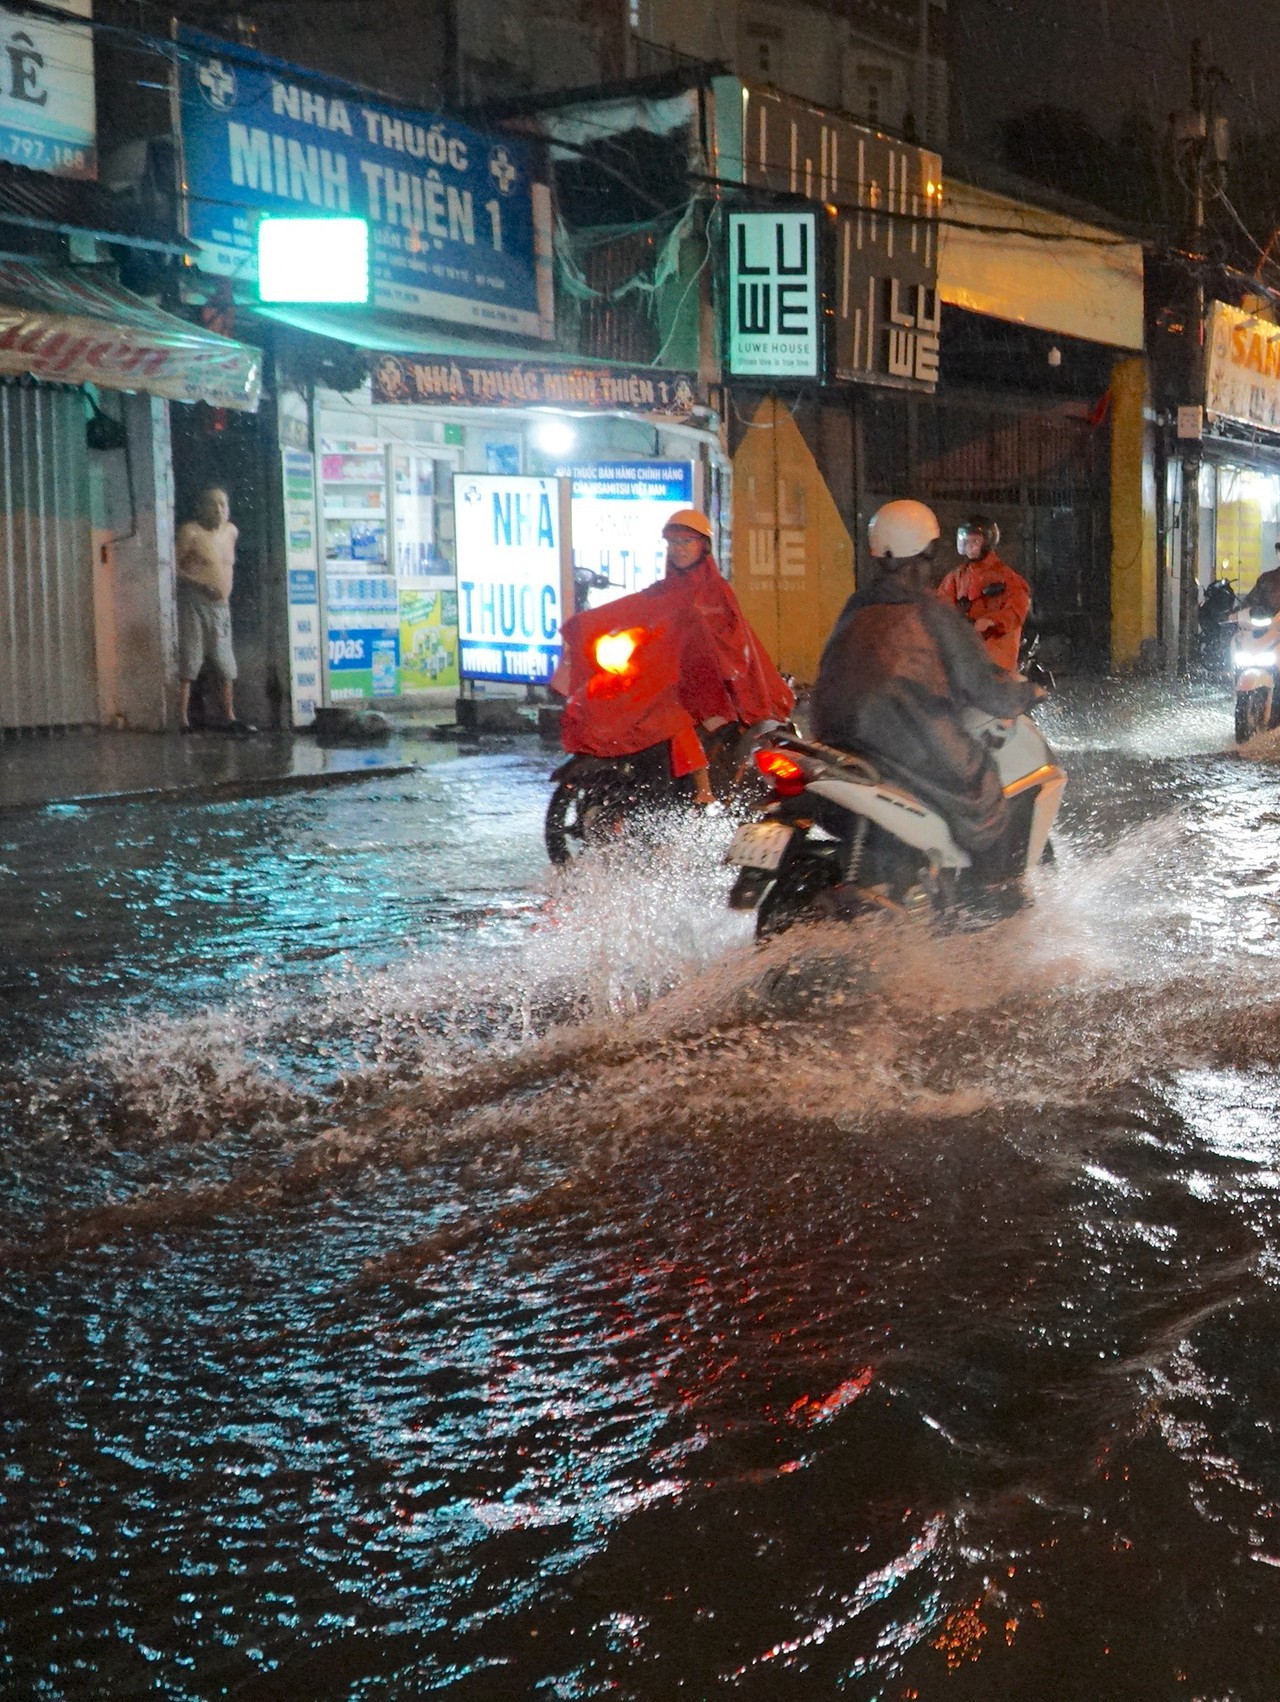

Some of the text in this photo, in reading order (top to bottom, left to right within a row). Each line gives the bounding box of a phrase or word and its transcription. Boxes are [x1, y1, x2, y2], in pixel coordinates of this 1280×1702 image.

[361, 110, 469, 172] THUỐC
[226, 121, 502, 250] MINH THIỆN 1
[738, 343, 810, 354] LUWE HOUSE
[414, 358, 669, 406] NHÀ THUỐC MINH THIỆN 1
[637, 466, 661, 480] CHÍNH
[492, 480, 555, 548] NHÀ
